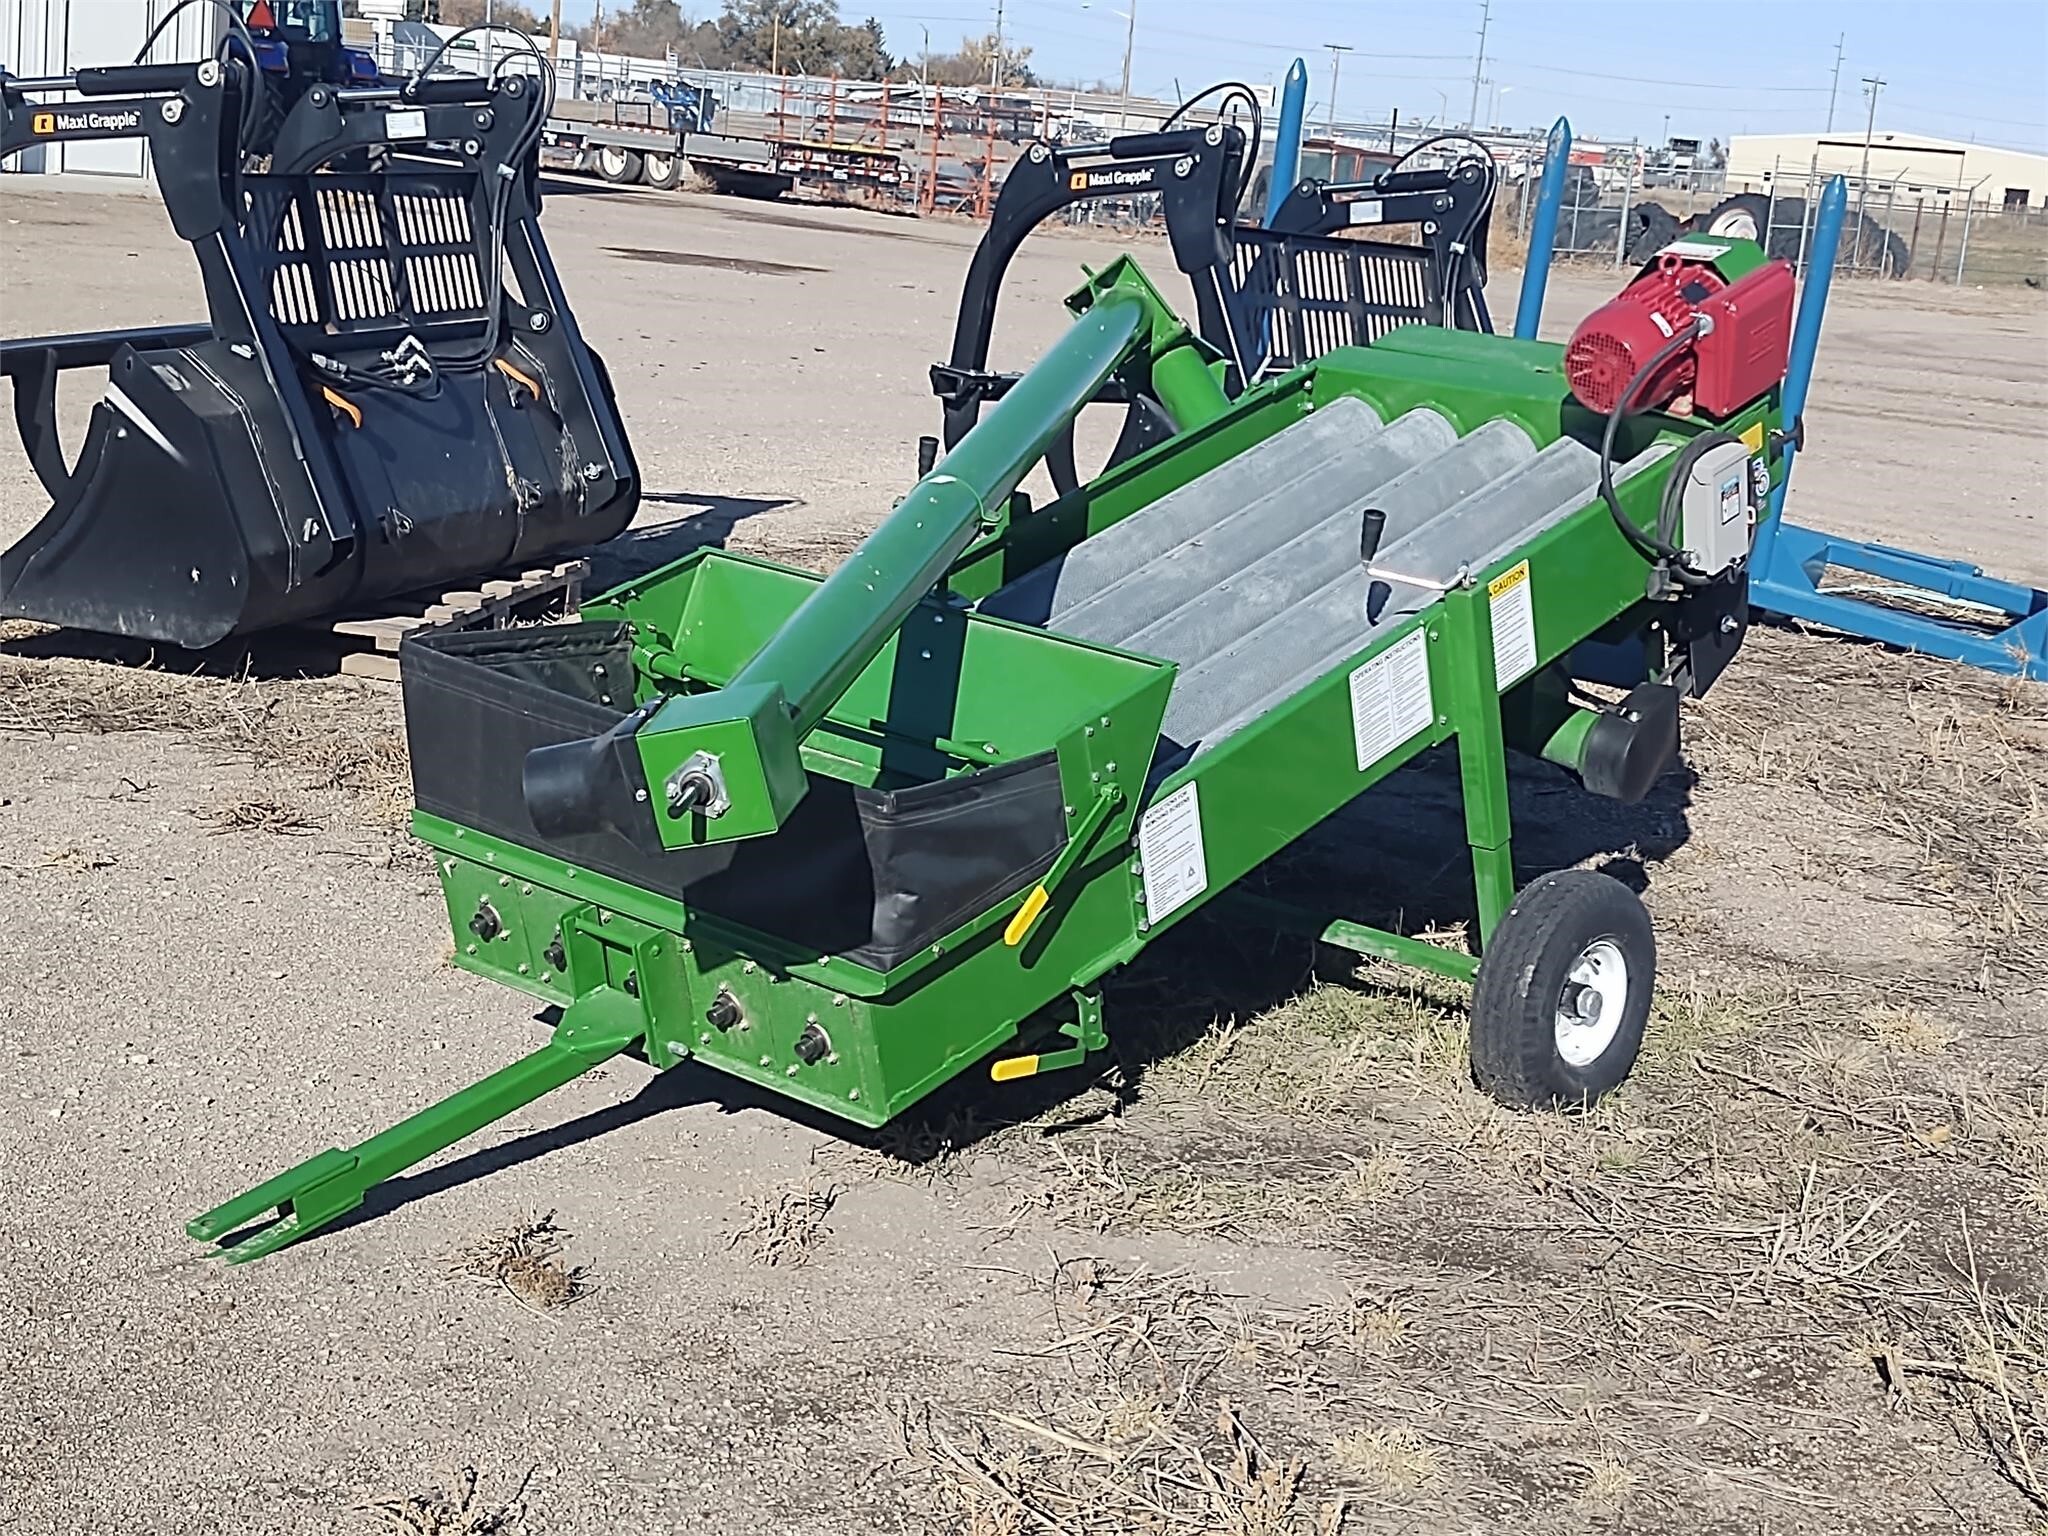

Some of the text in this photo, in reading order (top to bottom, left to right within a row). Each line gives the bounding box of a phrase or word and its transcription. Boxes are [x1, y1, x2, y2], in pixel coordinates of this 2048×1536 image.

[57, 114, 88, 130] Maxi
[1089, 172, 1113, 187] Maxi
[1492, 567, 1525, 594] CAUTION
[1354, 633, 1421, 682] OPERATING INSTRUCTIONS
